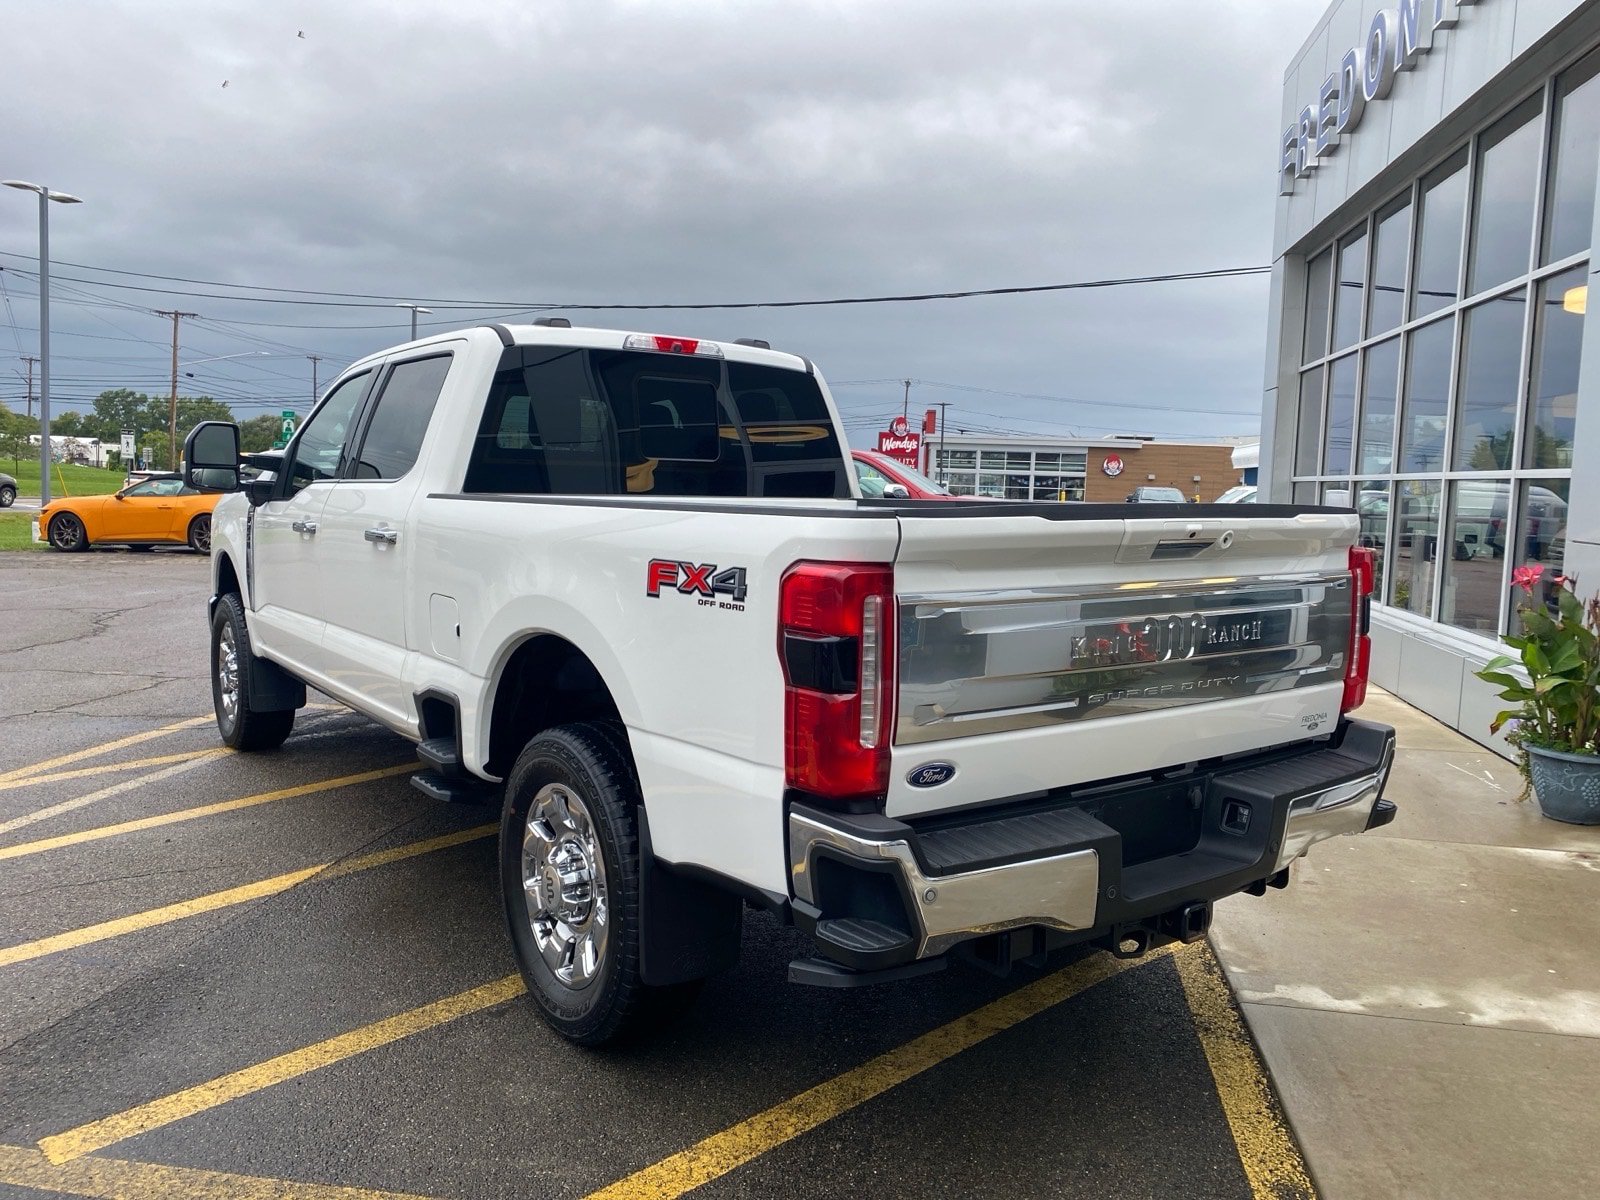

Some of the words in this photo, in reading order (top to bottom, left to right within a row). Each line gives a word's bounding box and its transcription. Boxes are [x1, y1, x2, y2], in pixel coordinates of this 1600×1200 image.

[882, 436, 918, 452] Wendy's
[647, 558, 747, 602] FX4
[697, 599, 716, 608] OFF
[718, 601, 745, 612] ROAD
[1207, 620, 1262, 644] RANCH
[1088, 684, 1174, 704] SUPER
[1181, 675, 1240, 691] DUTY
[919, 768, 947, 783] Ford
